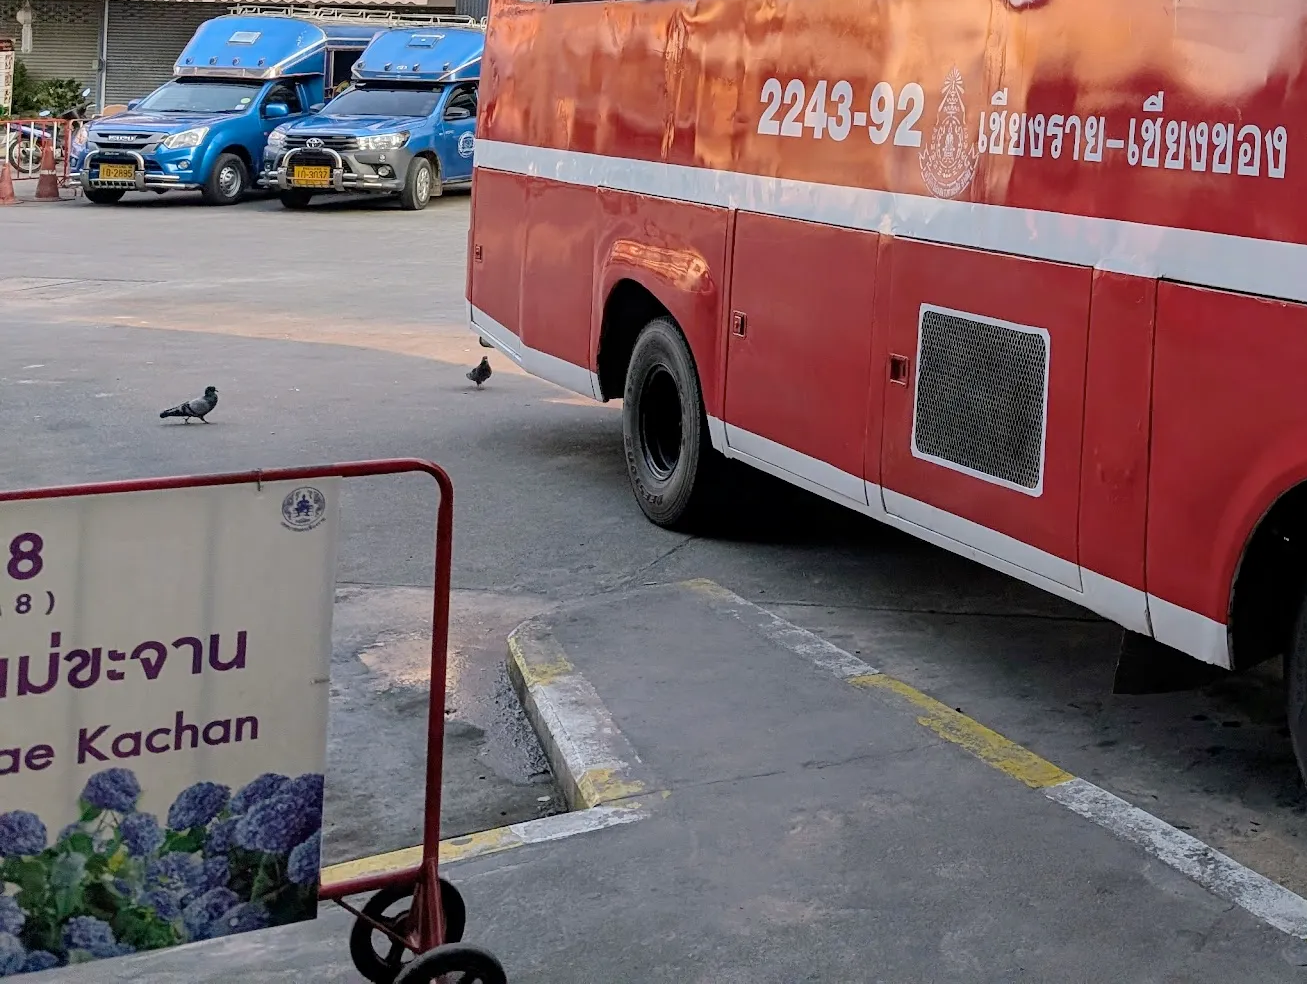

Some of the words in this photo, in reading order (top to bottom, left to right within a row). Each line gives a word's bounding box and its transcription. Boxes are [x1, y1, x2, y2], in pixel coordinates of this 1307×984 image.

[757, 77, 924, 147] 2243-92
[978, 87, 1287, 179] เชียงราย-เชียงของ
[7, 532, 44, 580] 8
[77, 710, 260, 765] Kachan
